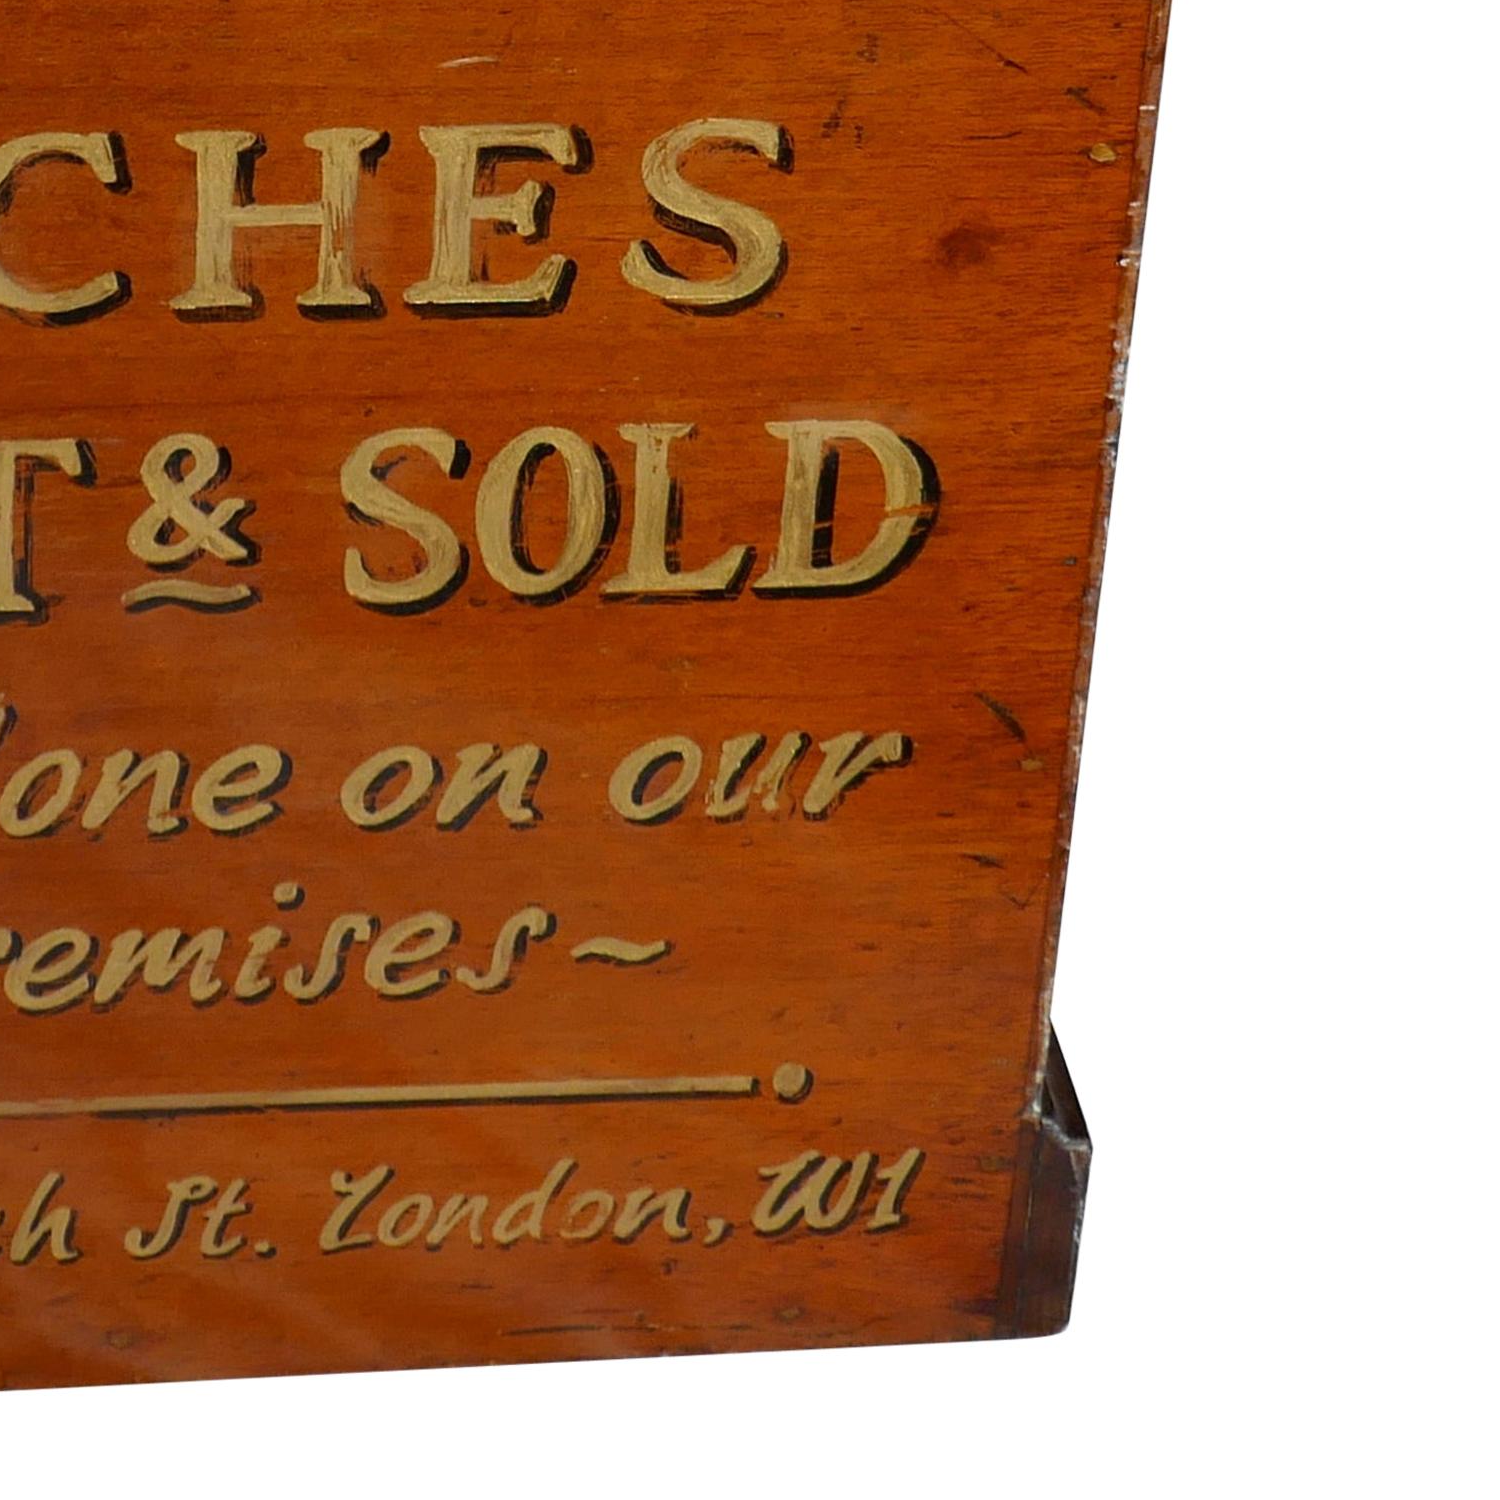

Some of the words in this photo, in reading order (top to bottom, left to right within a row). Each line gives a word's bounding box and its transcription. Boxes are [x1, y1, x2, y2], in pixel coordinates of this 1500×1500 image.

[127, 434, 250, 564] &
[341, 419, 930, 604] SOLD
[339, 740, 541, 827] on
[609, 732, 903, 822] our
[753, 1148, 924, 1232] W1
